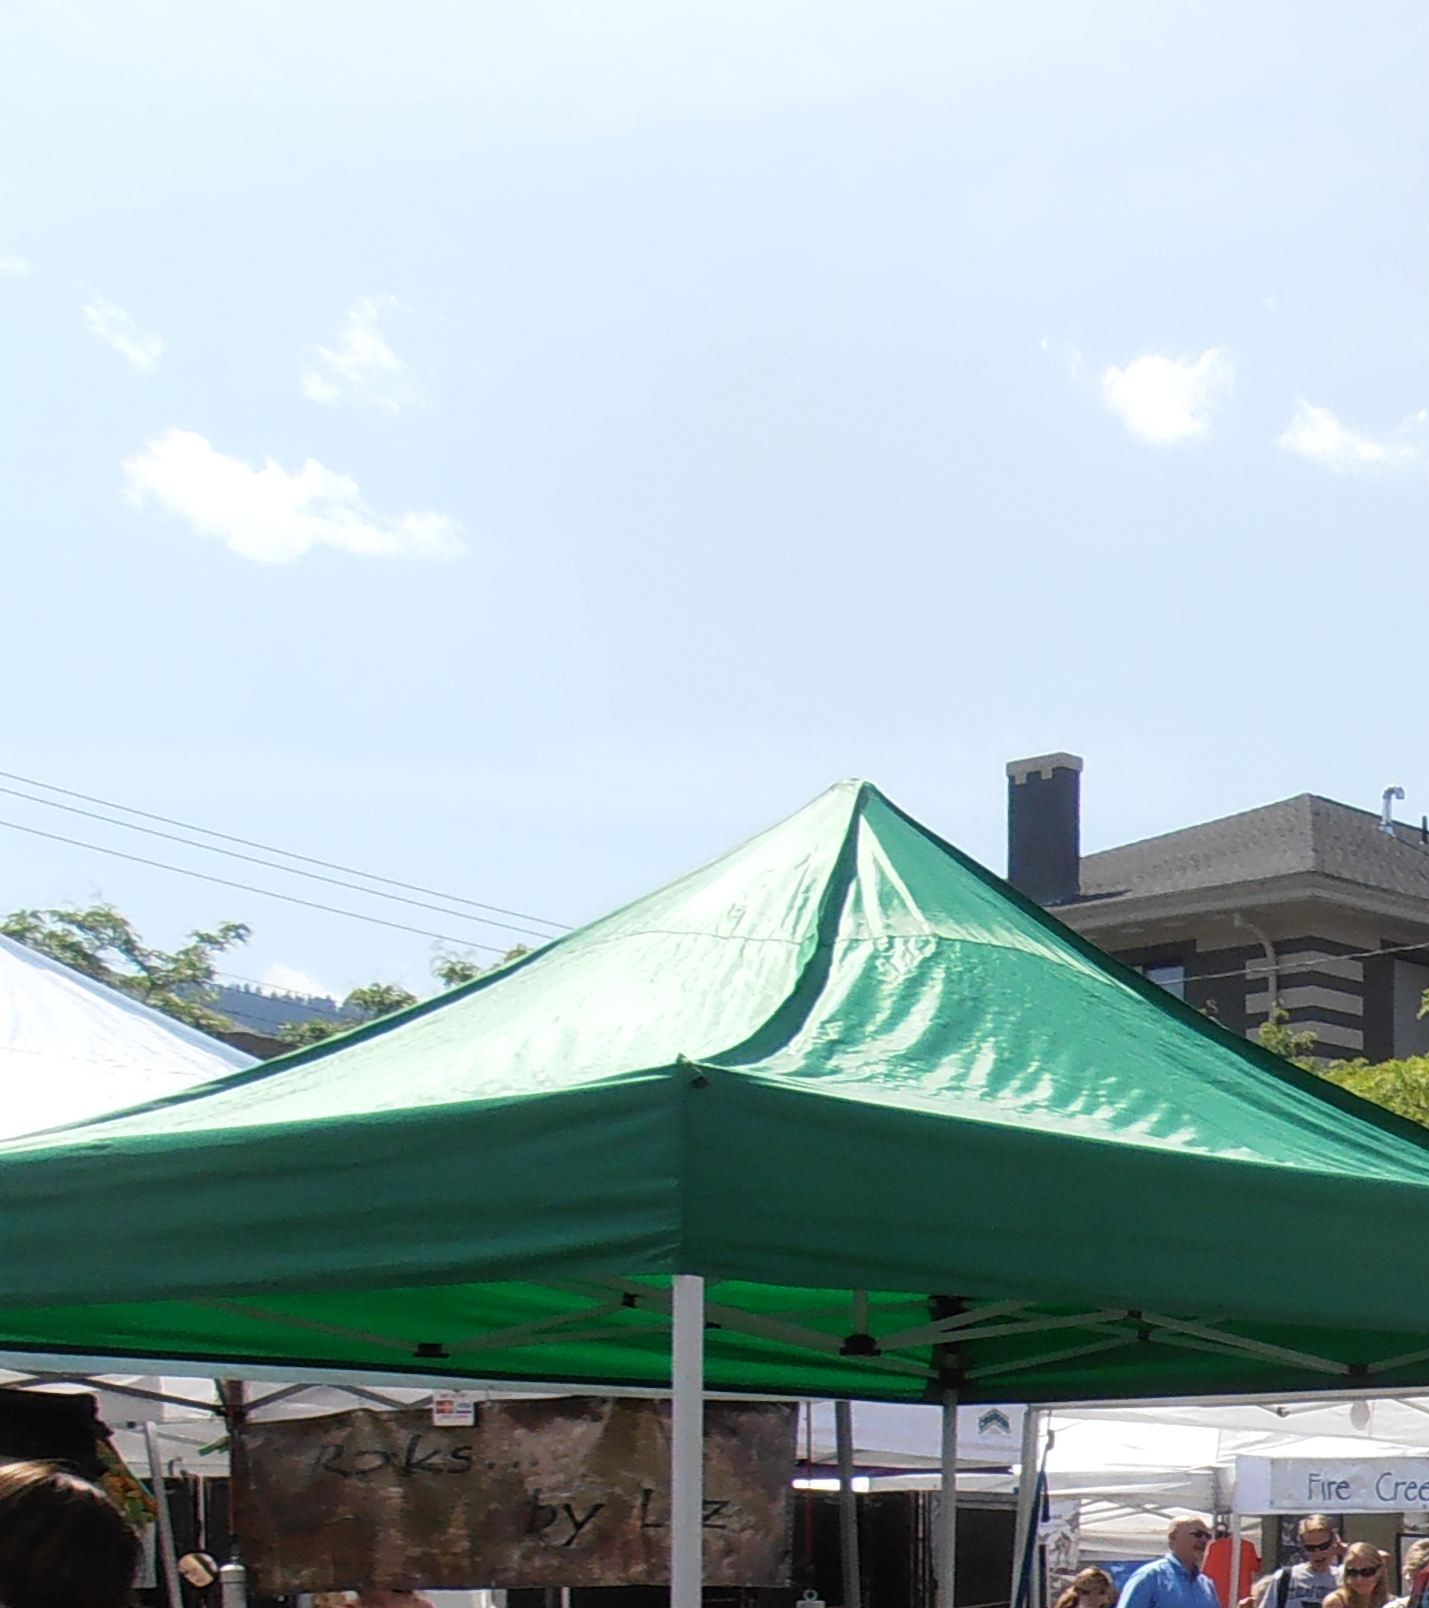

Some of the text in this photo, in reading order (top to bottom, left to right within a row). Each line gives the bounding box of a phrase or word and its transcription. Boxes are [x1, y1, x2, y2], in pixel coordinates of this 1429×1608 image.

[1306, 1472, 1352, 1501] Fire
[525, 1487, 729, 1547] by Lz
